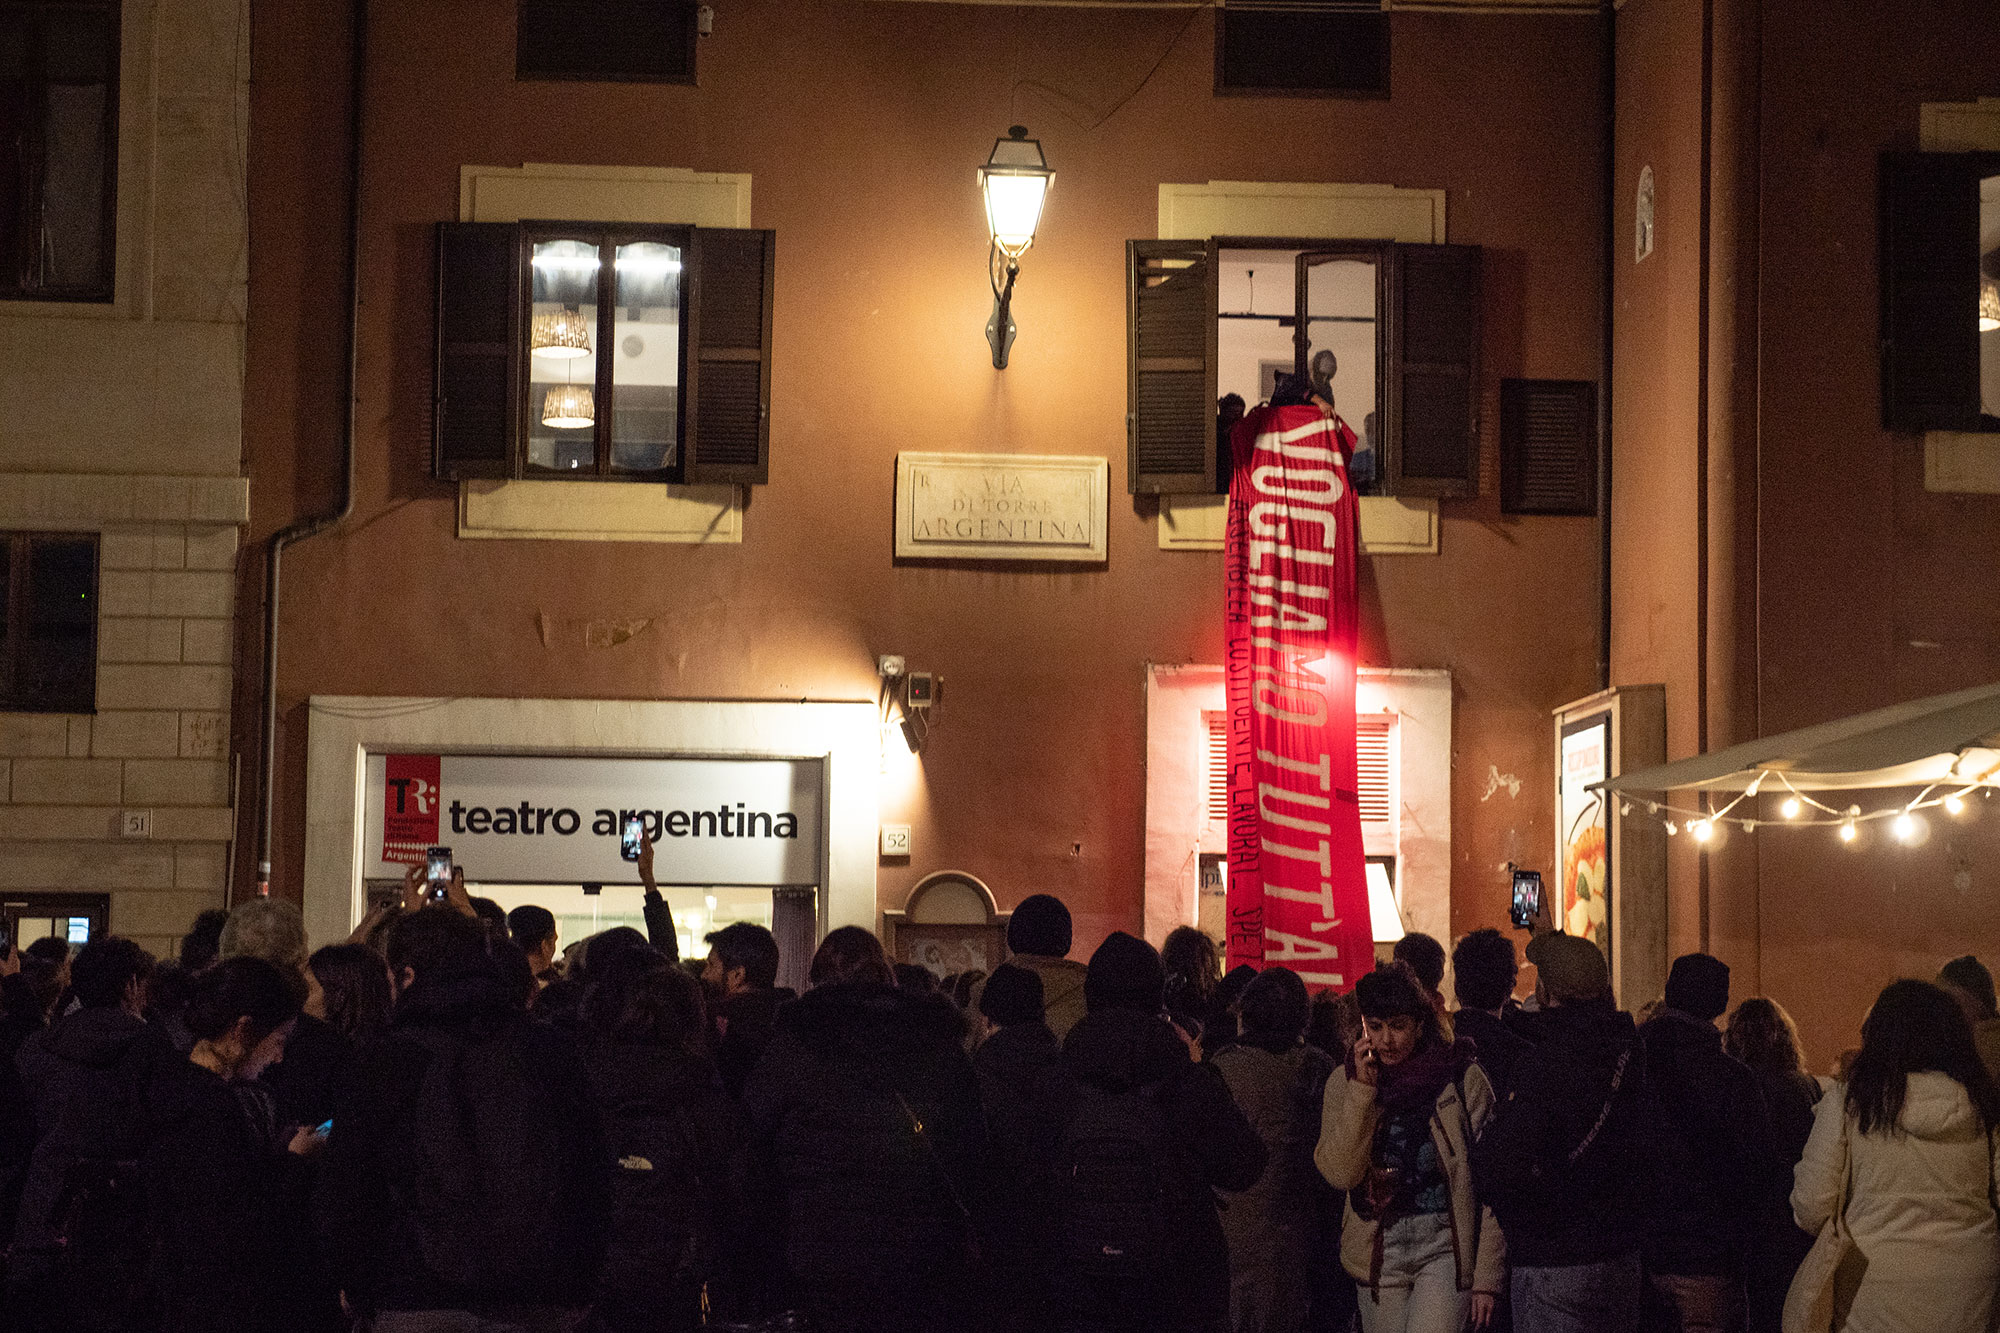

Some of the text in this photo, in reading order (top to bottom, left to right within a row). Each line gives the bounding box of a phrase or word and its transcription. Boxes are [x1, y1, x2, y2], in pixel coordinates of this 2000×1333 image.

[983, 474, 1024, 494] VIA
[953, 498, 1053, 514] DI TORRE
[917, 517, 1086, 540] ARGENTINA
[1247, 417, 1344, 728] VOGLIAMO
[130, 816, 144, 831] 51
[449, 799, 799, 843] teatro argentina
[887, 833, 906, 847] 52
